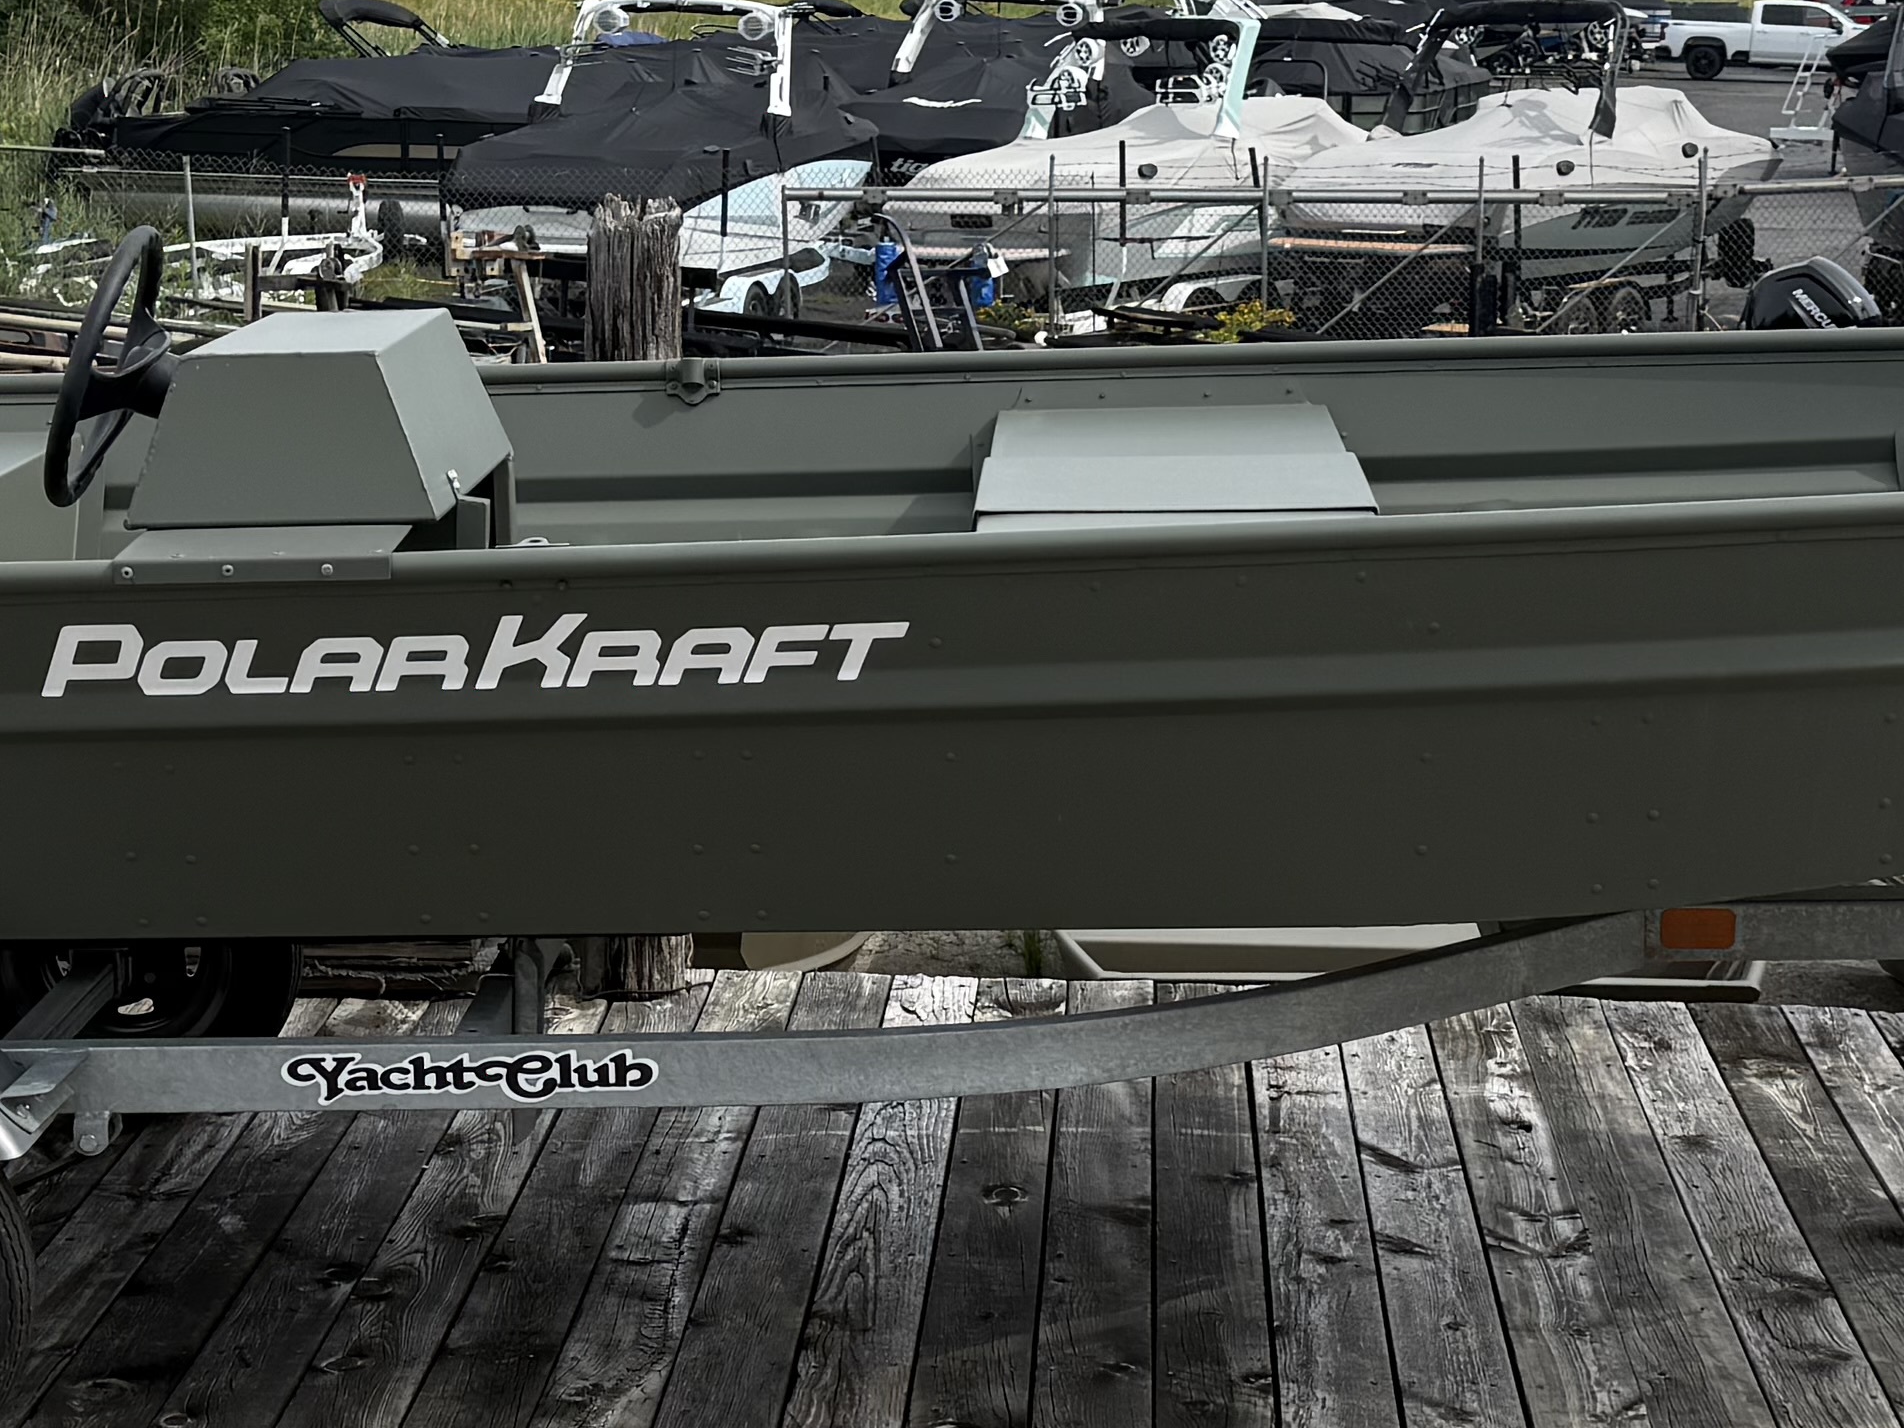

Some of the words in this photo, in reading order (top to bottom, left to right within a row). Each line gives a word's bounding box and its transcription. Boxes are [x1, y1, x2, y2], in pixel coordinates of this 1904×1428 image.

[1792, 288, 1837, 329] MERCU
[286, 1052, 480, 1102] Yacht
[474, 1050, 654, 1099] Club
